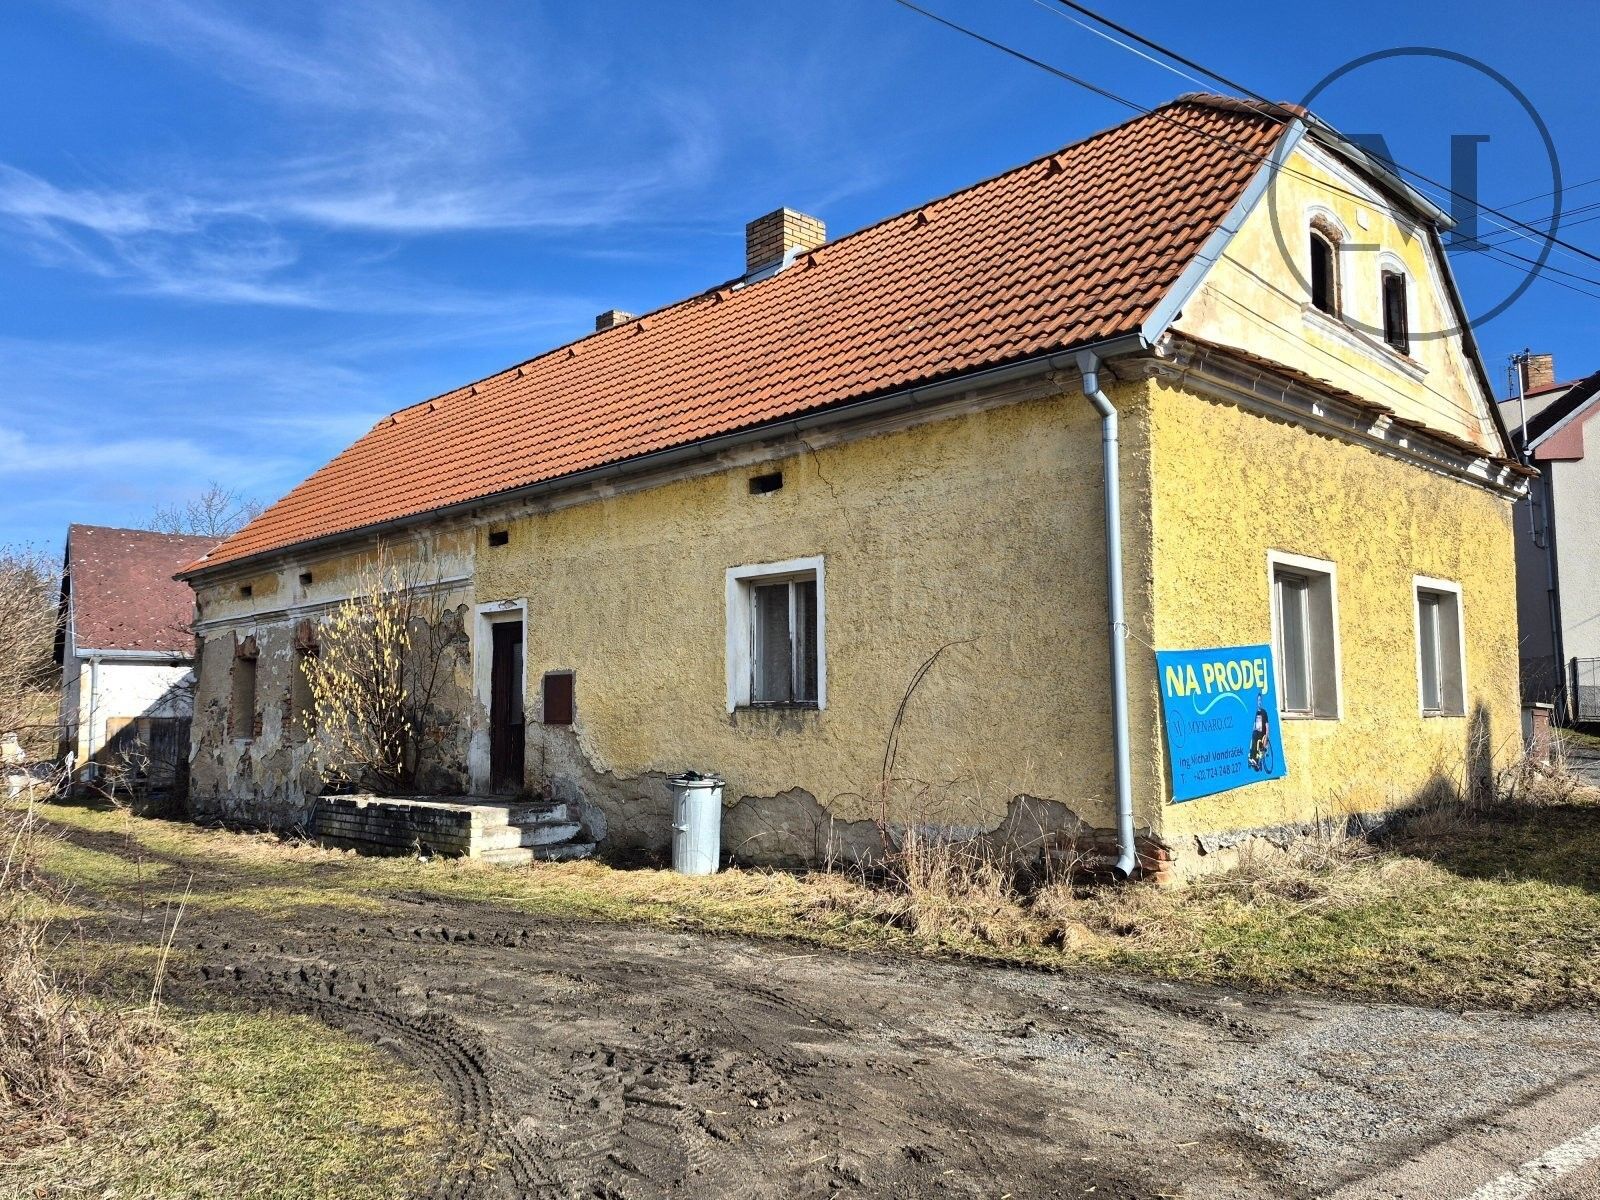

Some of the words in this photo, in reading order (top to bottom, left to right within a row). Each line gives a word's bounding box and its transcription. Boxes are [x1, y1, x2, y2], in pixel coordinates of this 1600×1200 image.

[1166, 665, 1201, 697] NA
[1202, 658, 1268, 694] PRODEJ
[1191, 753, 1211, 764] Michal
[1206, 767, 1218, 779] 724
